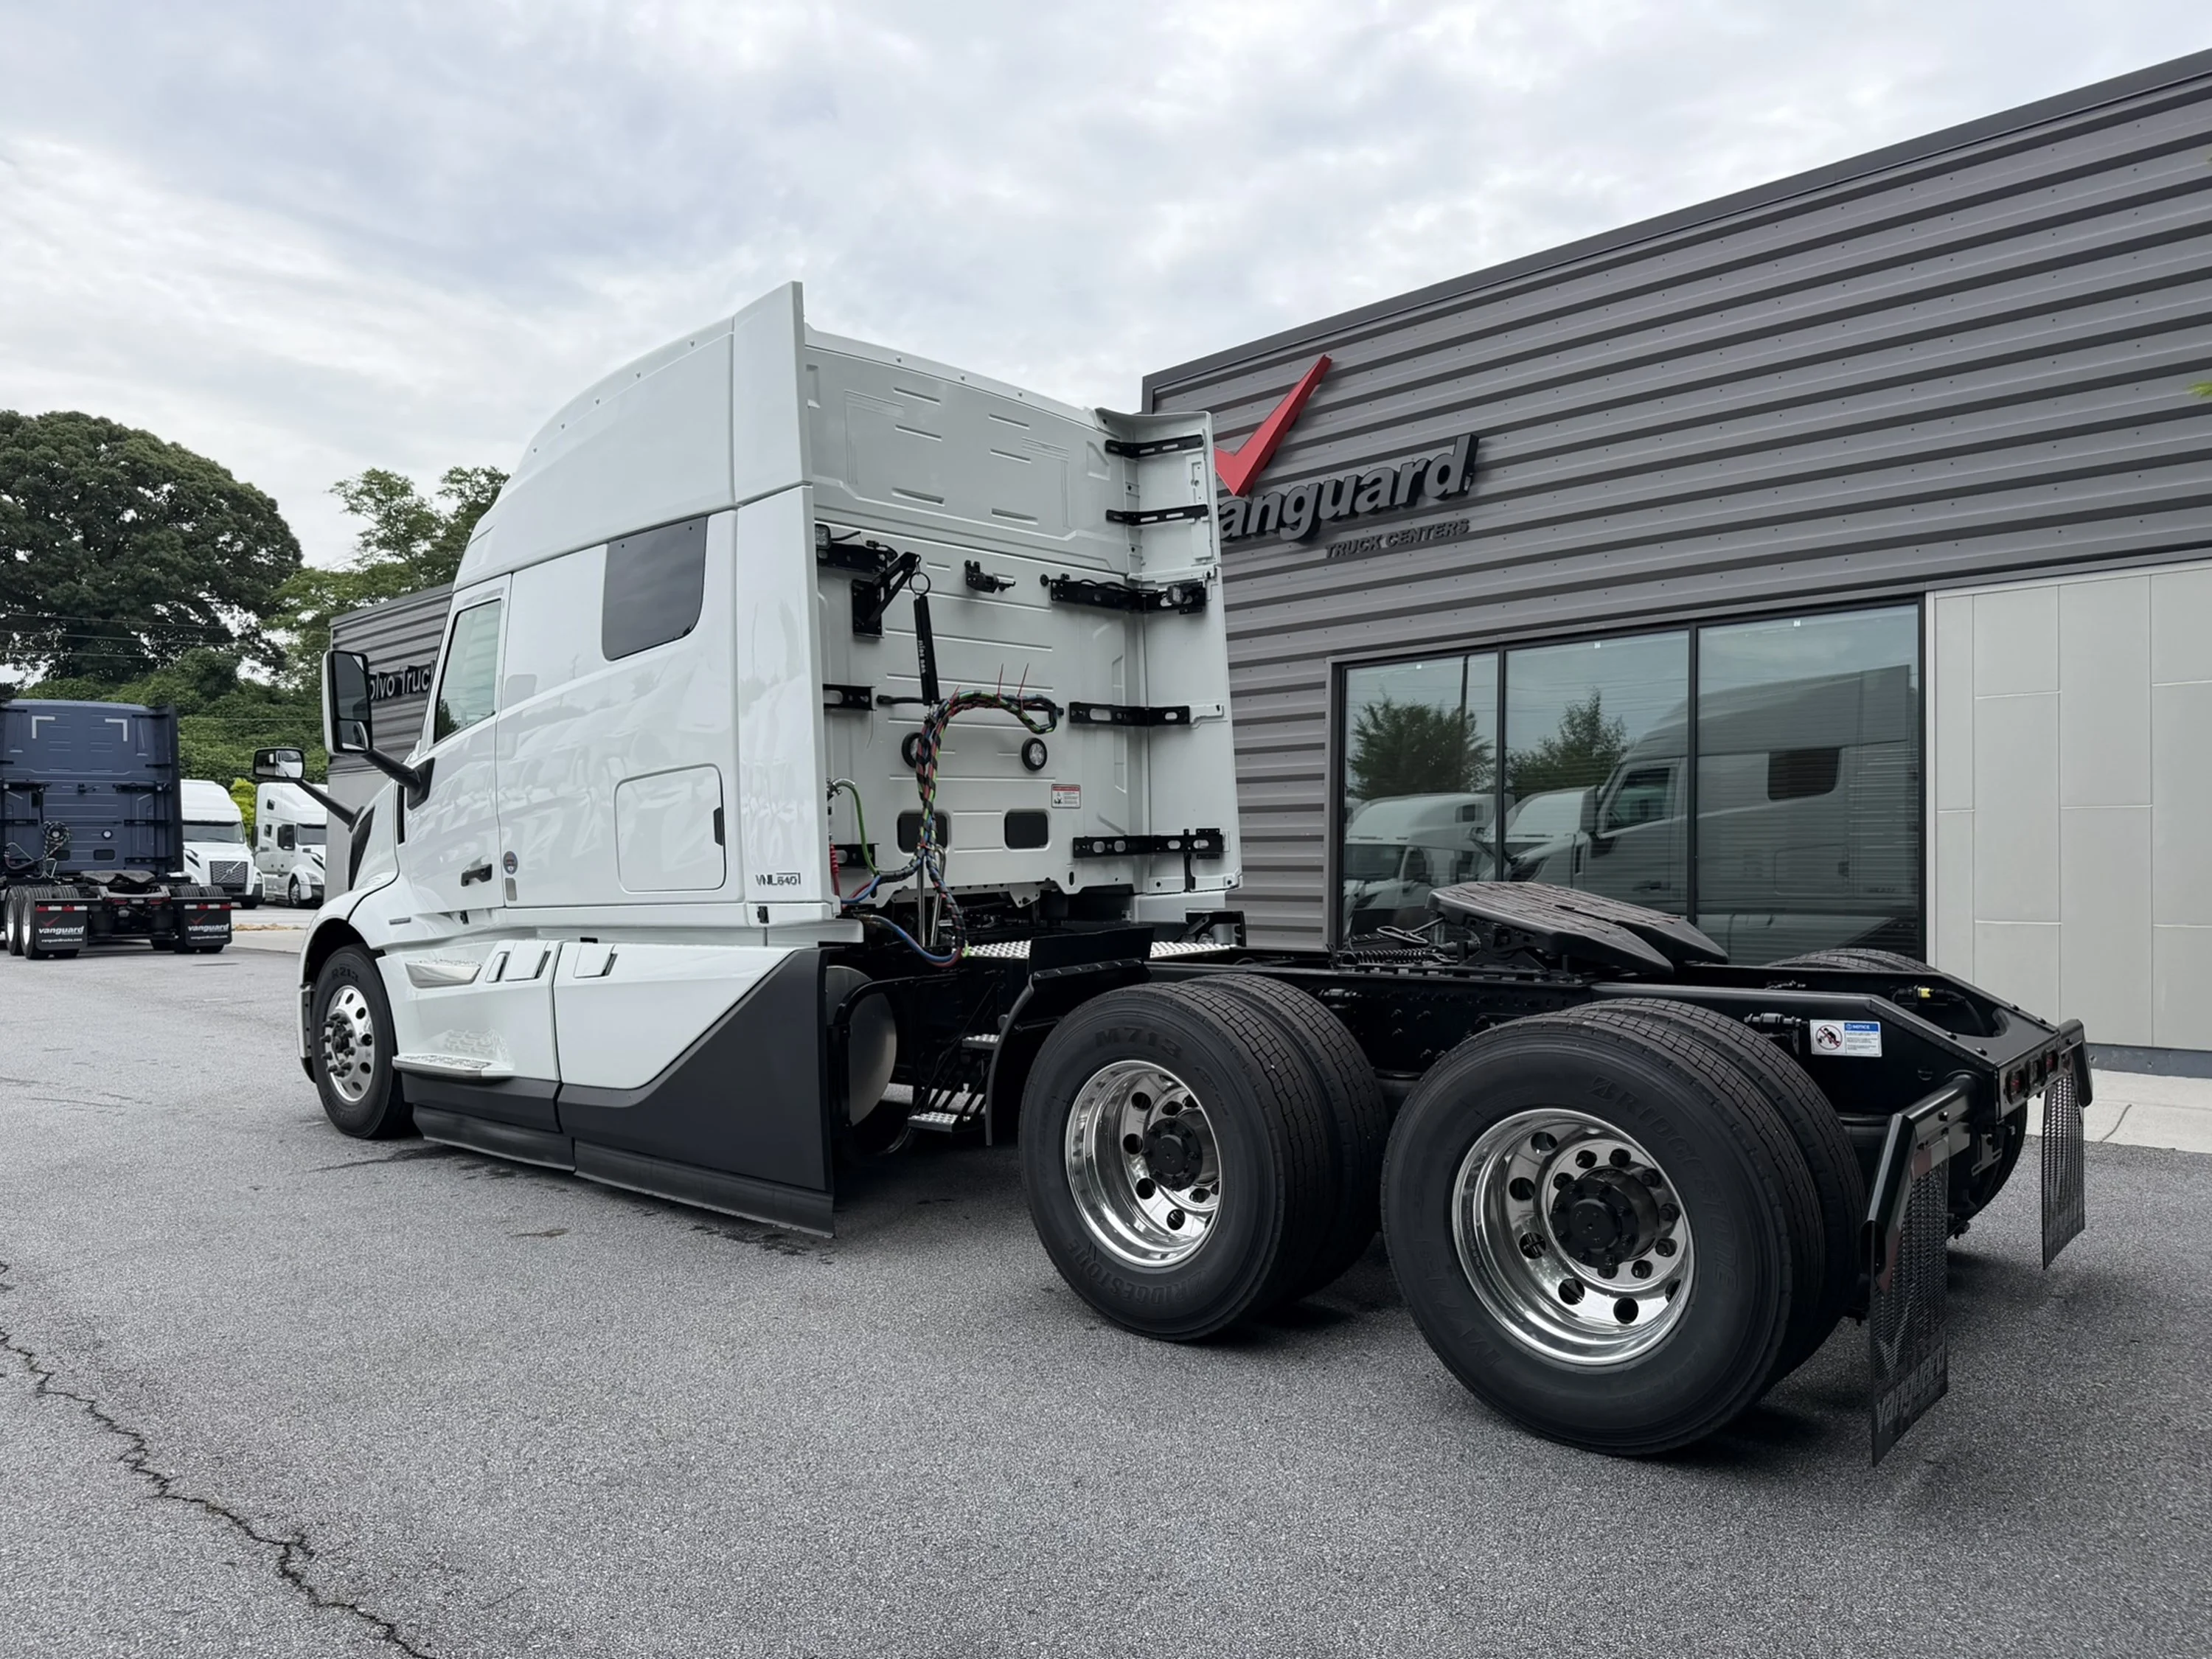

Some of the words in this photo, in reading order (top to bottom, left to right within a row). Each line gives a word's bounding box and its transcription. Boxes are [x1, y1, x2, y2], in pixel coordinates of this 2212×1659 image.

[1211, 434, 1478, 541] anguard
[1326, 535, 1382, 558] TRUCK
[1385, 518, 1470, 549] CENTERS
[370, 671, 395, 700] olvo
[38, 926, 84, 935] vanguard
[188, 923, 229, 932] vanguard
